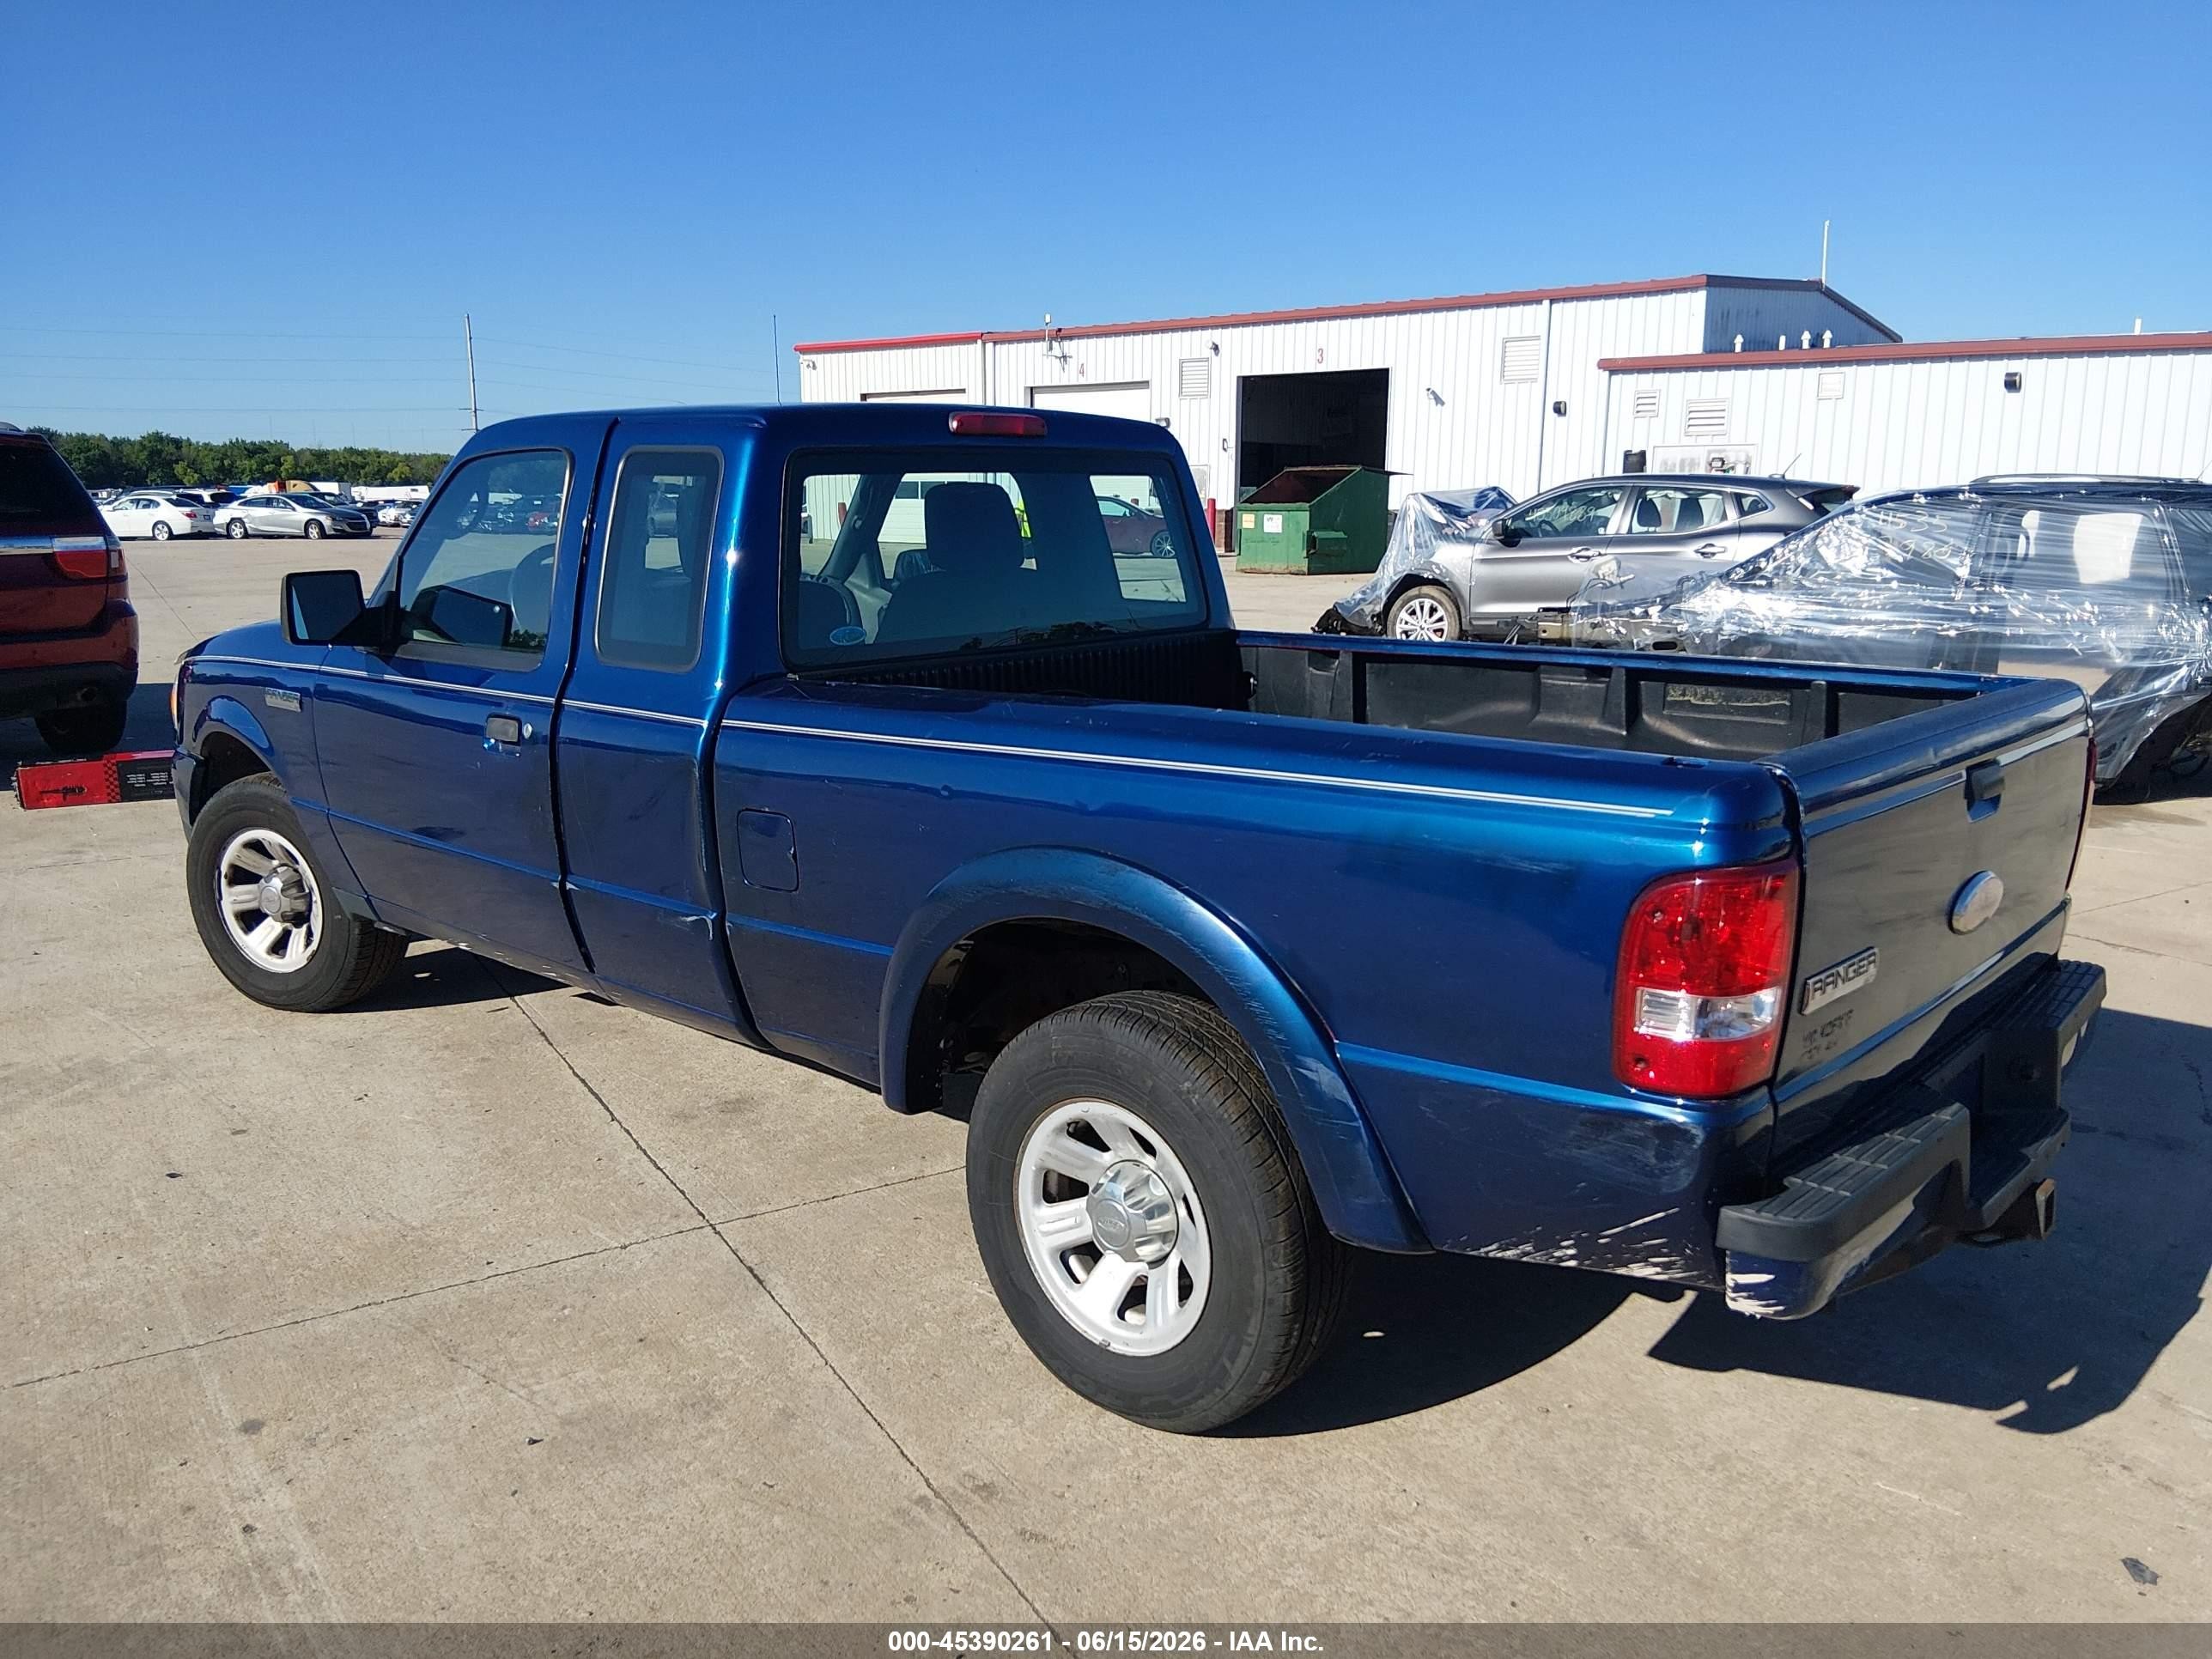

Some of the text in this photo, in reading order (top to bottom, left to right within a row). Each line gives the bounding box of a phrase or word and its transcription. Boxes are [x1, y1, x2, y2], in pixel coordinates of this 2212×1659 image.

[1317, 348, 1323, 364] 3
[1079, 363, 1085, 378] 4
[1809, 951, 1876, 1000] RANGER
